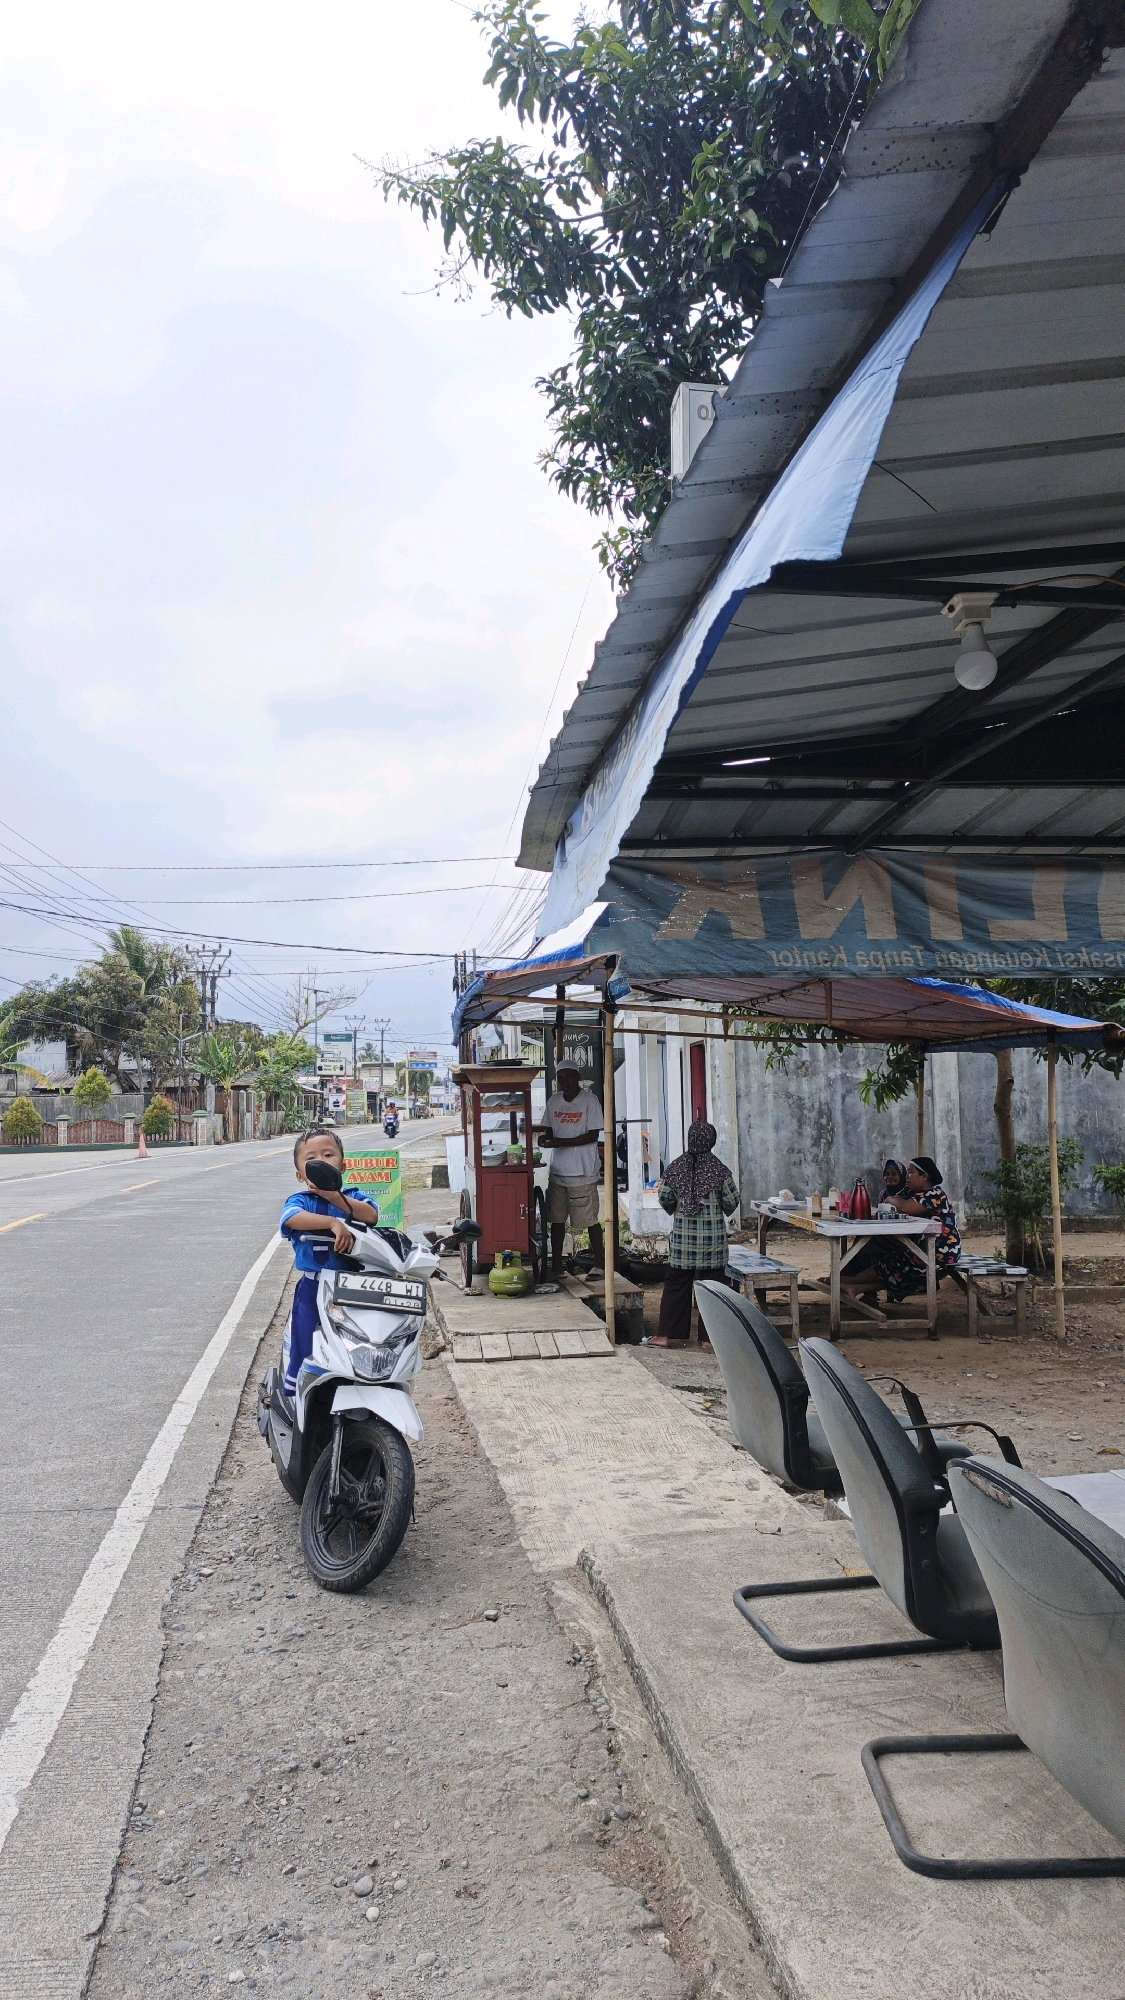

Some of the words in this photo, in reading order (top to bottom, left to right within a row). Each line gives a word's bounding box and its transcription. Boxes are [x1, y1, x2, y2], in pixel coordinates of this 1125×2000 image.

[343, 1157, 398, 1169] BUBUR
[346, 1171, 392, 1184] AYAM
[341, 1276, 348, 1288] Z
[360, 1278, 392, 1293] 4448
